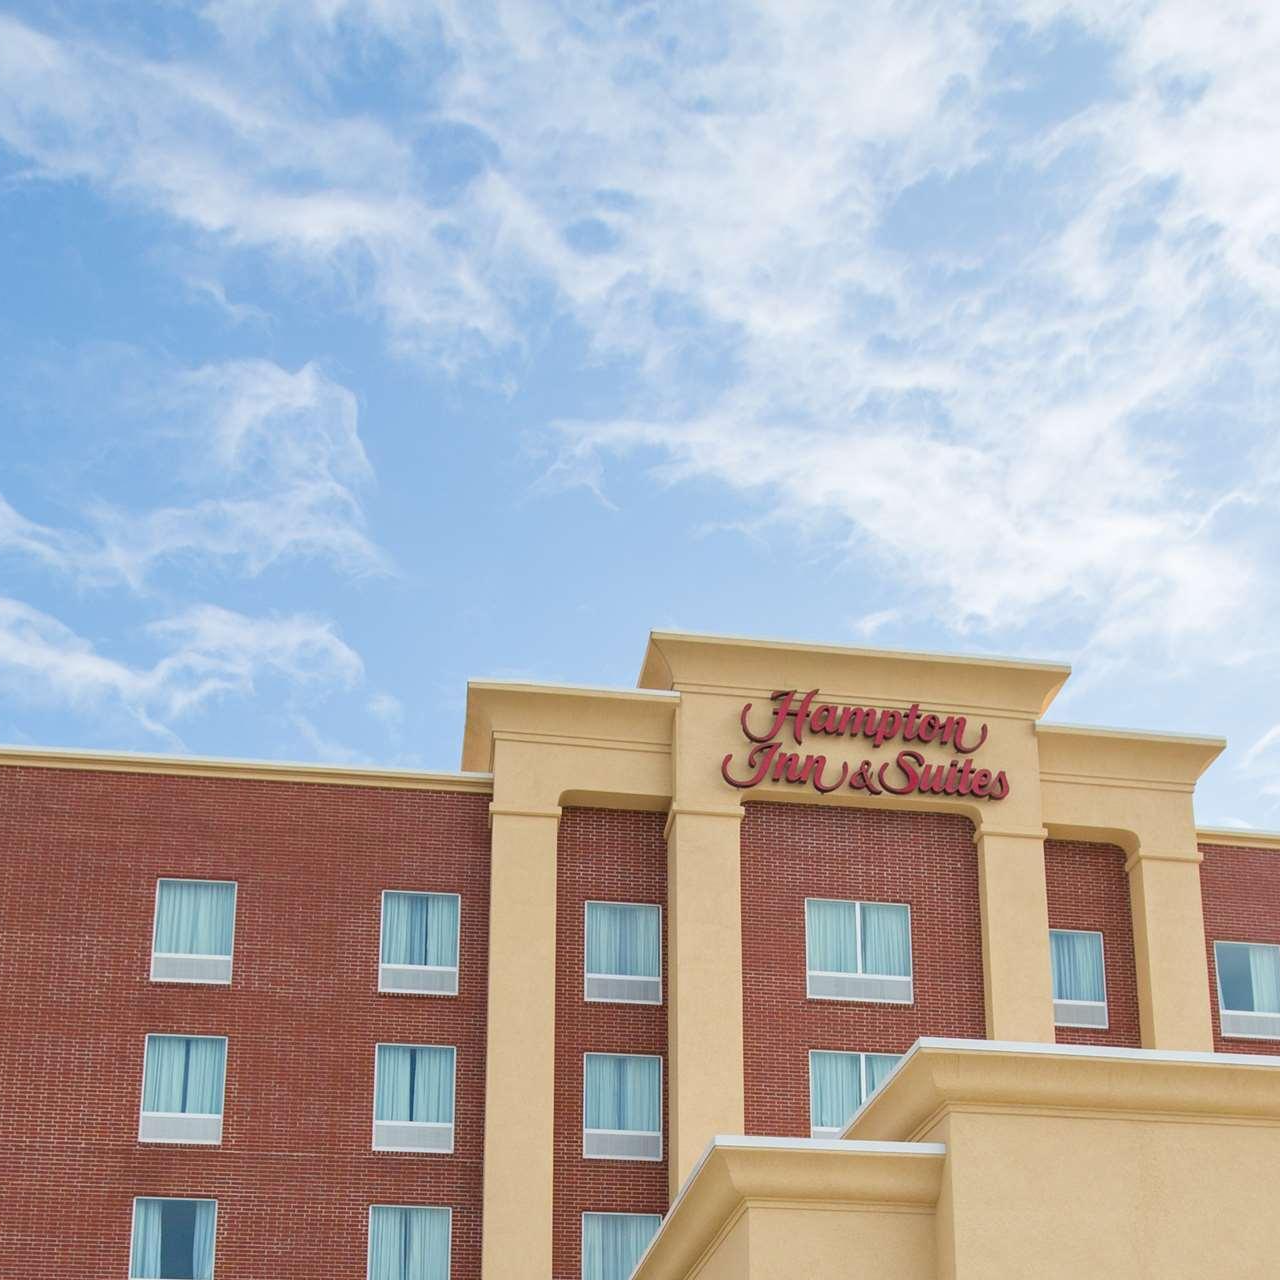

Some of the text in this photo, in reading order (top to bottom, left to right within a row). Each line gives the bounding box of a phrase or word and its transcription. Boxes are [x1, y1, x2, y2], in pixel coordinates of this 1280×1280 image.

[741, 689, 988, 754] Hampton
[721, 742, 1010, 800] Inn & Suites
